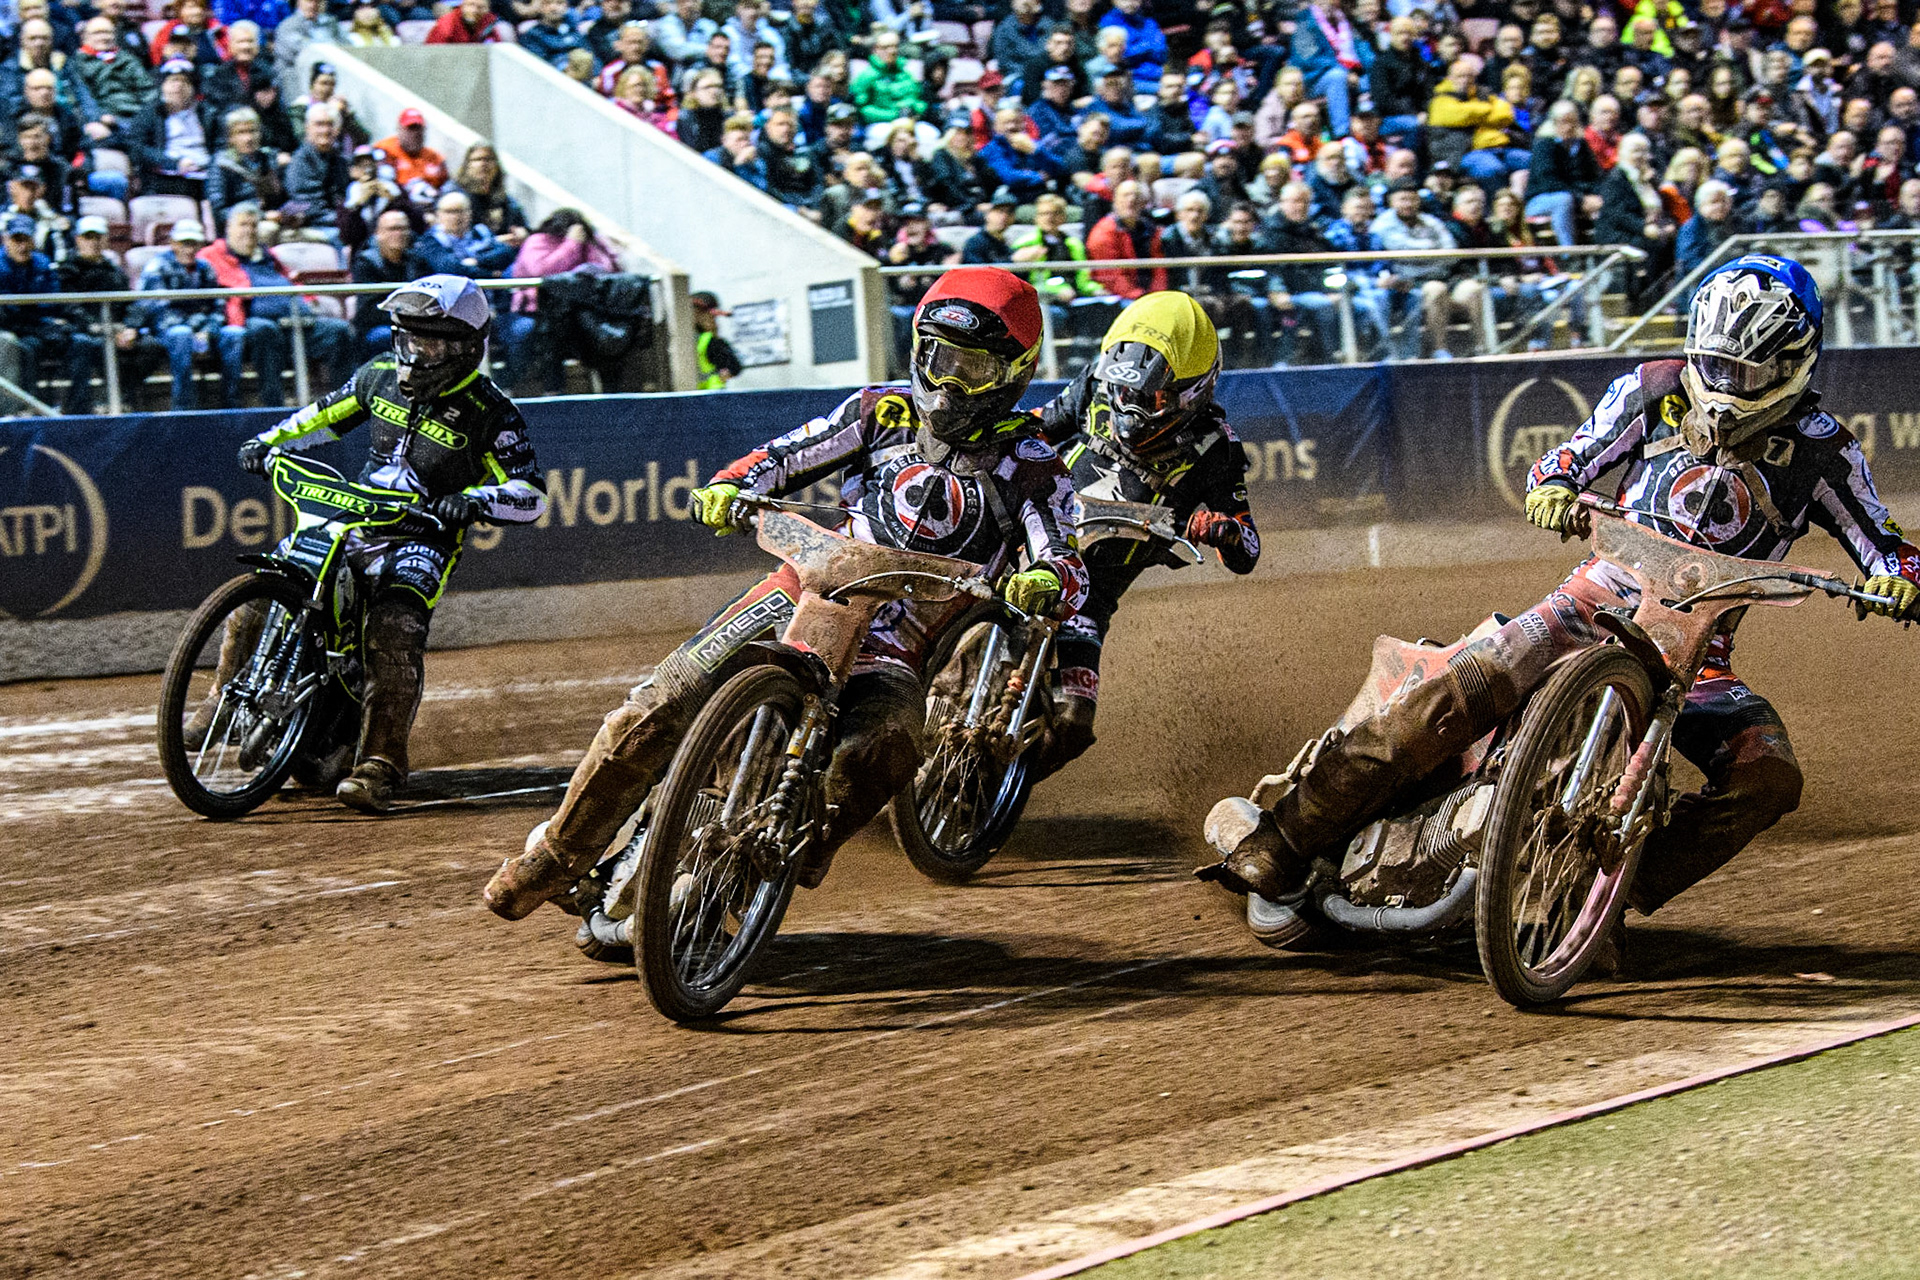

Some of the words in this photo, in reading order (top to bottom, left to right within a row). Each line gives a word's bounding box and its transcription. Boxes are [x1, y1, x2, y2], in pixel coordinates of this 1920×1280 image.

[1706, 336, 1738, 351] SHOEI
[442, 405, 462, 423] 2
[1767, 437, 1790, 462] 7
[1668, 456, 1708, 478] BELL
[301, 485, 333, 500] TRU
[333, 493, 371, 514] MIX
[534, 460, 698, 528] World
